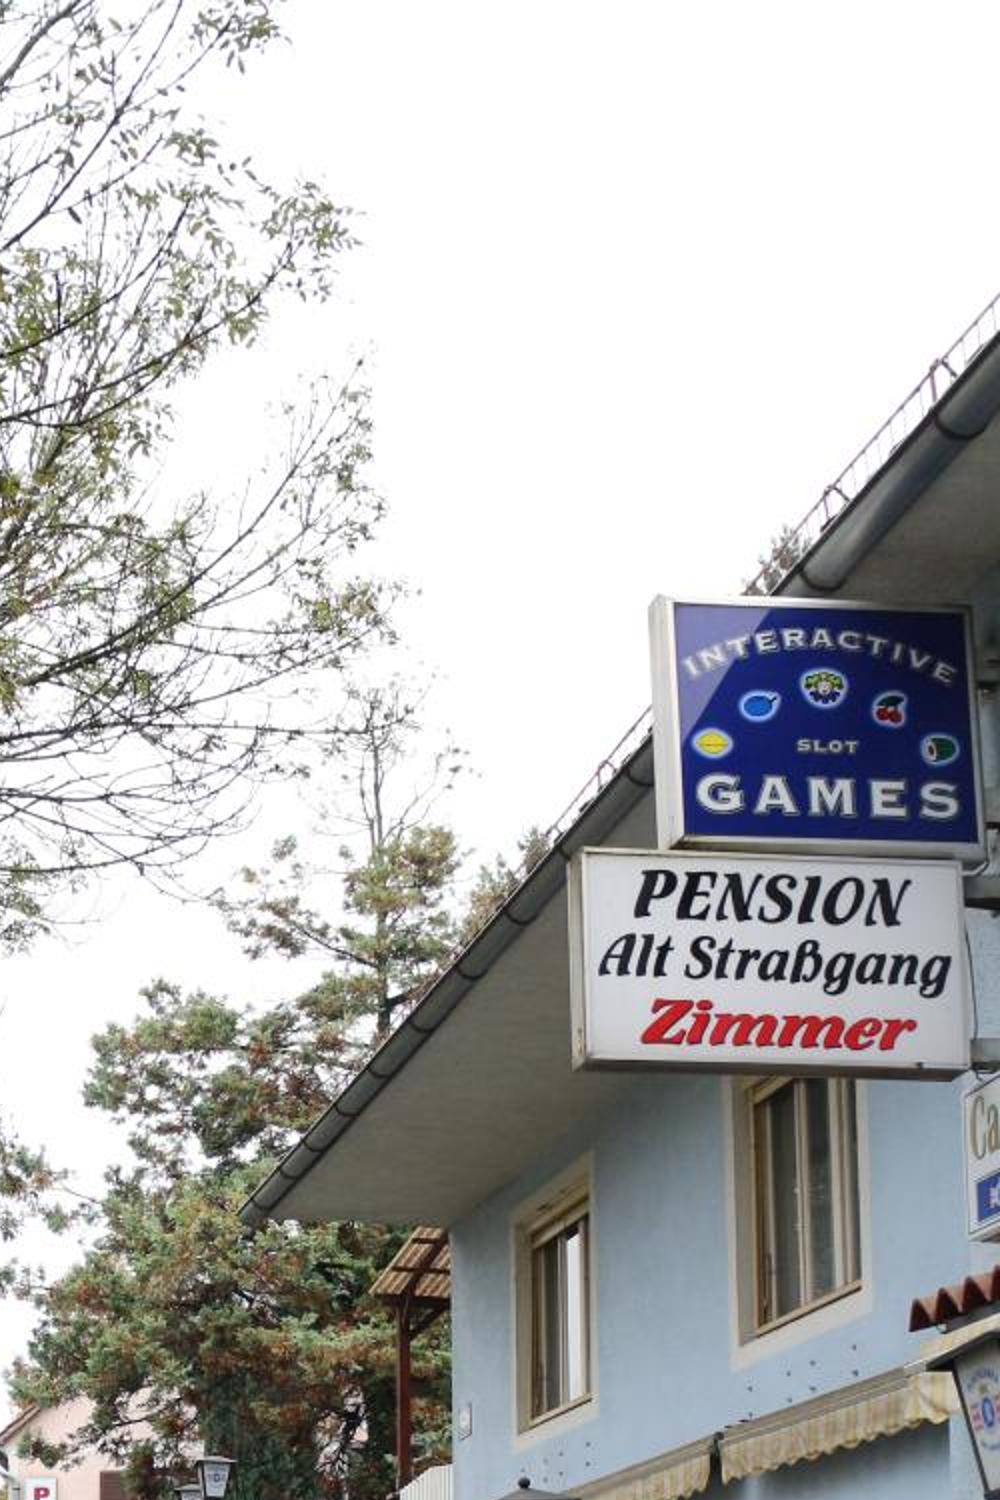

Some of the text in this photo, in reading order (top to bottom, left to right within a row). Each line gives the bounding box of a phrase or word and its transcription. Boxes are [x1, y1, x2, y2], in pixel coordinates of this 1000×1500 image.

[683, 627, 958, 687] INTERACTIVE
[796, 738, 859, 753] SLOT
[696, 772, 961, 819] GAMES
[634, 869, 912, 926] PENSION
[598, 932, 952, 999] Alt Straßgang
[640, 997, 918, 1051] Zimmer
